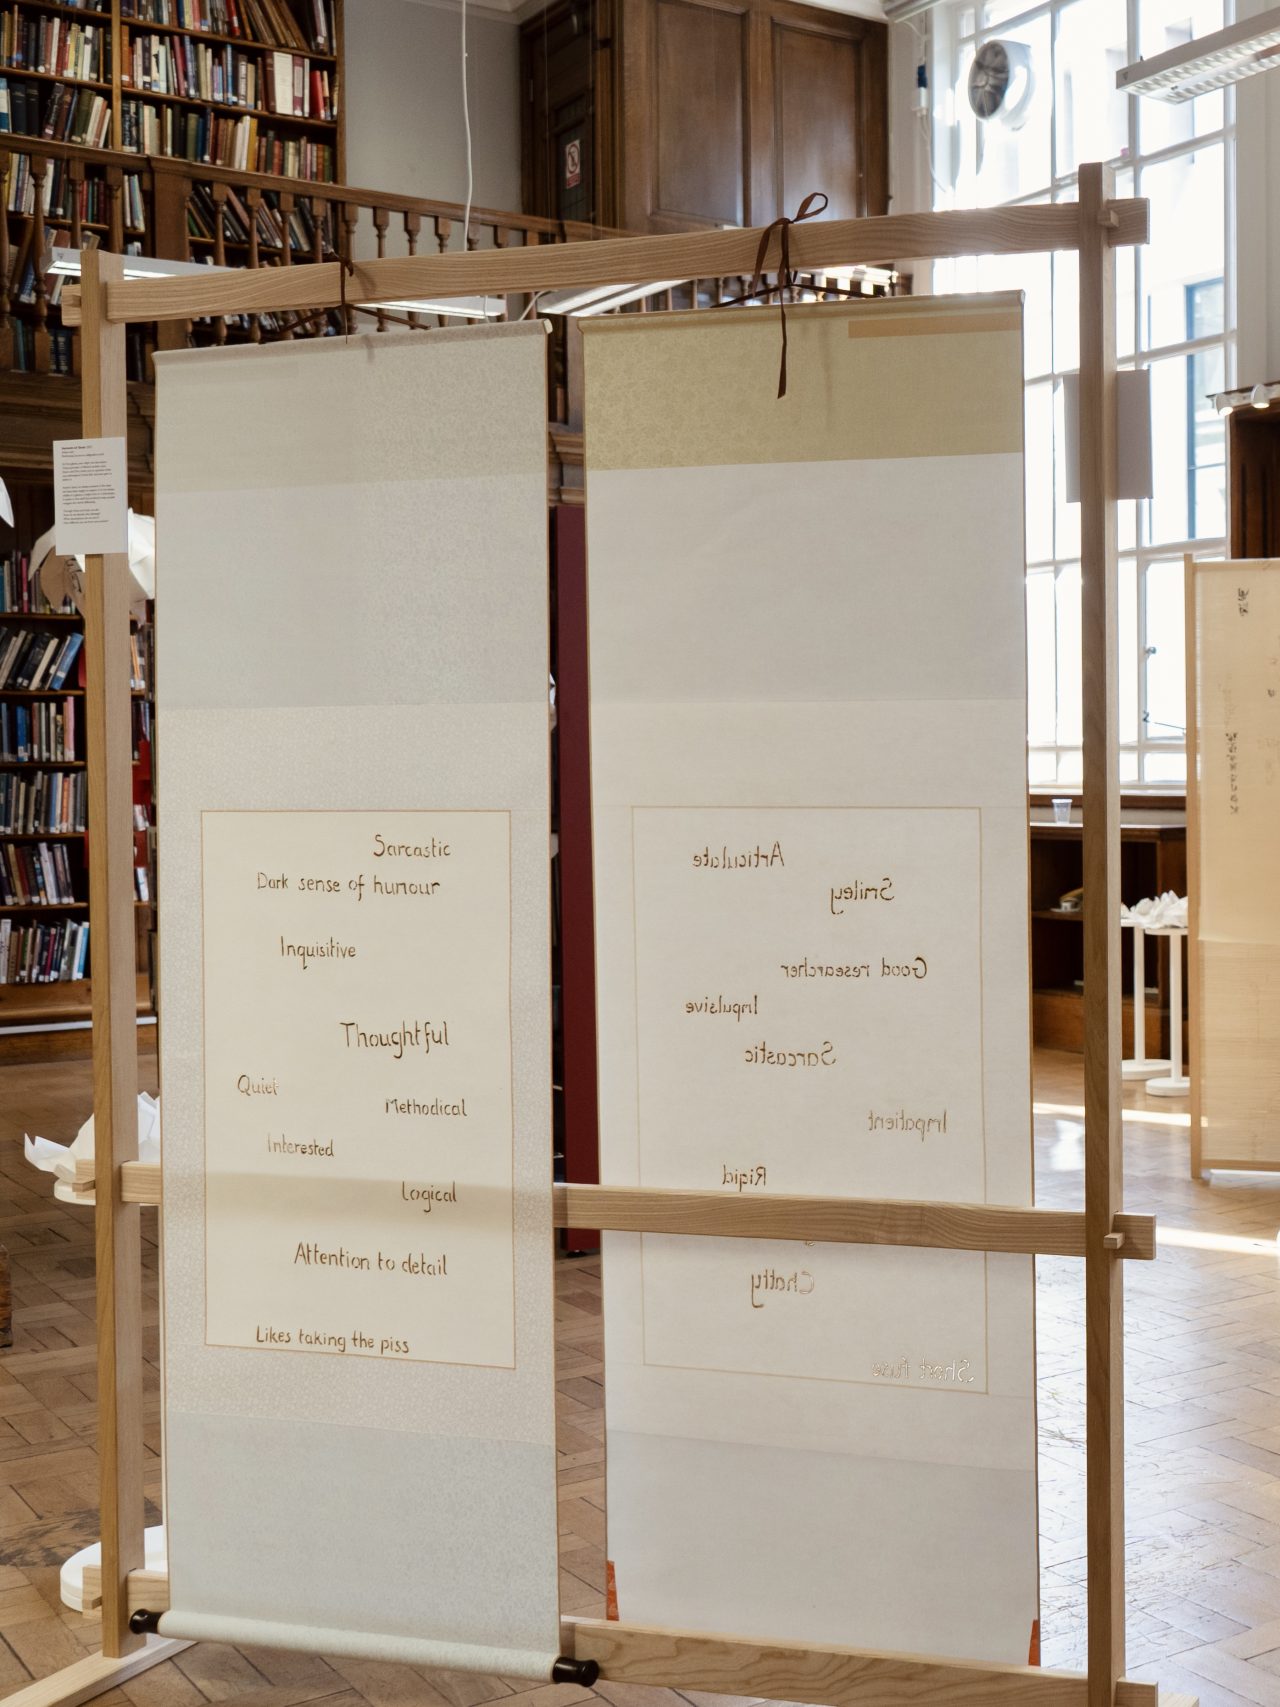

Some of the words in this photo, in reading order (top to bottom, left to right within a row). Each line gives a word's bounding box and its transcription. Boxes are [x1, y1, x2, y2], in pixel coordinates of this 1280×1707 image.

[373, 834, 451, 858] Sarcastic
[257, 872, 288, 889] Dark
[298, 878, 341, 892] sense
[349, 874, 365, 901] of
[374, 875, 440, 895] humour
[281, 936, 356, 970] Inquisitive
[339, 1020, 449, 1059] Thoughtful
[237, 1075, 277, 1096] Quiet
[386, 1098, 467, 1116] Methodical
[268, 1134, 334, 1157] Interested
[402, 1182, 457, 1213] Logical
[294, 1242, 370, 1270] Attention
[378, 1251, 395, 1271] to
[402, 1253, 447, 1276] detail
[256, 1326, 291, 1343] Likes
[299, 1329, 346, 1352] taking
[352, 1331, 374, 1349] the
[381, 1337, 410, 1354] piss
